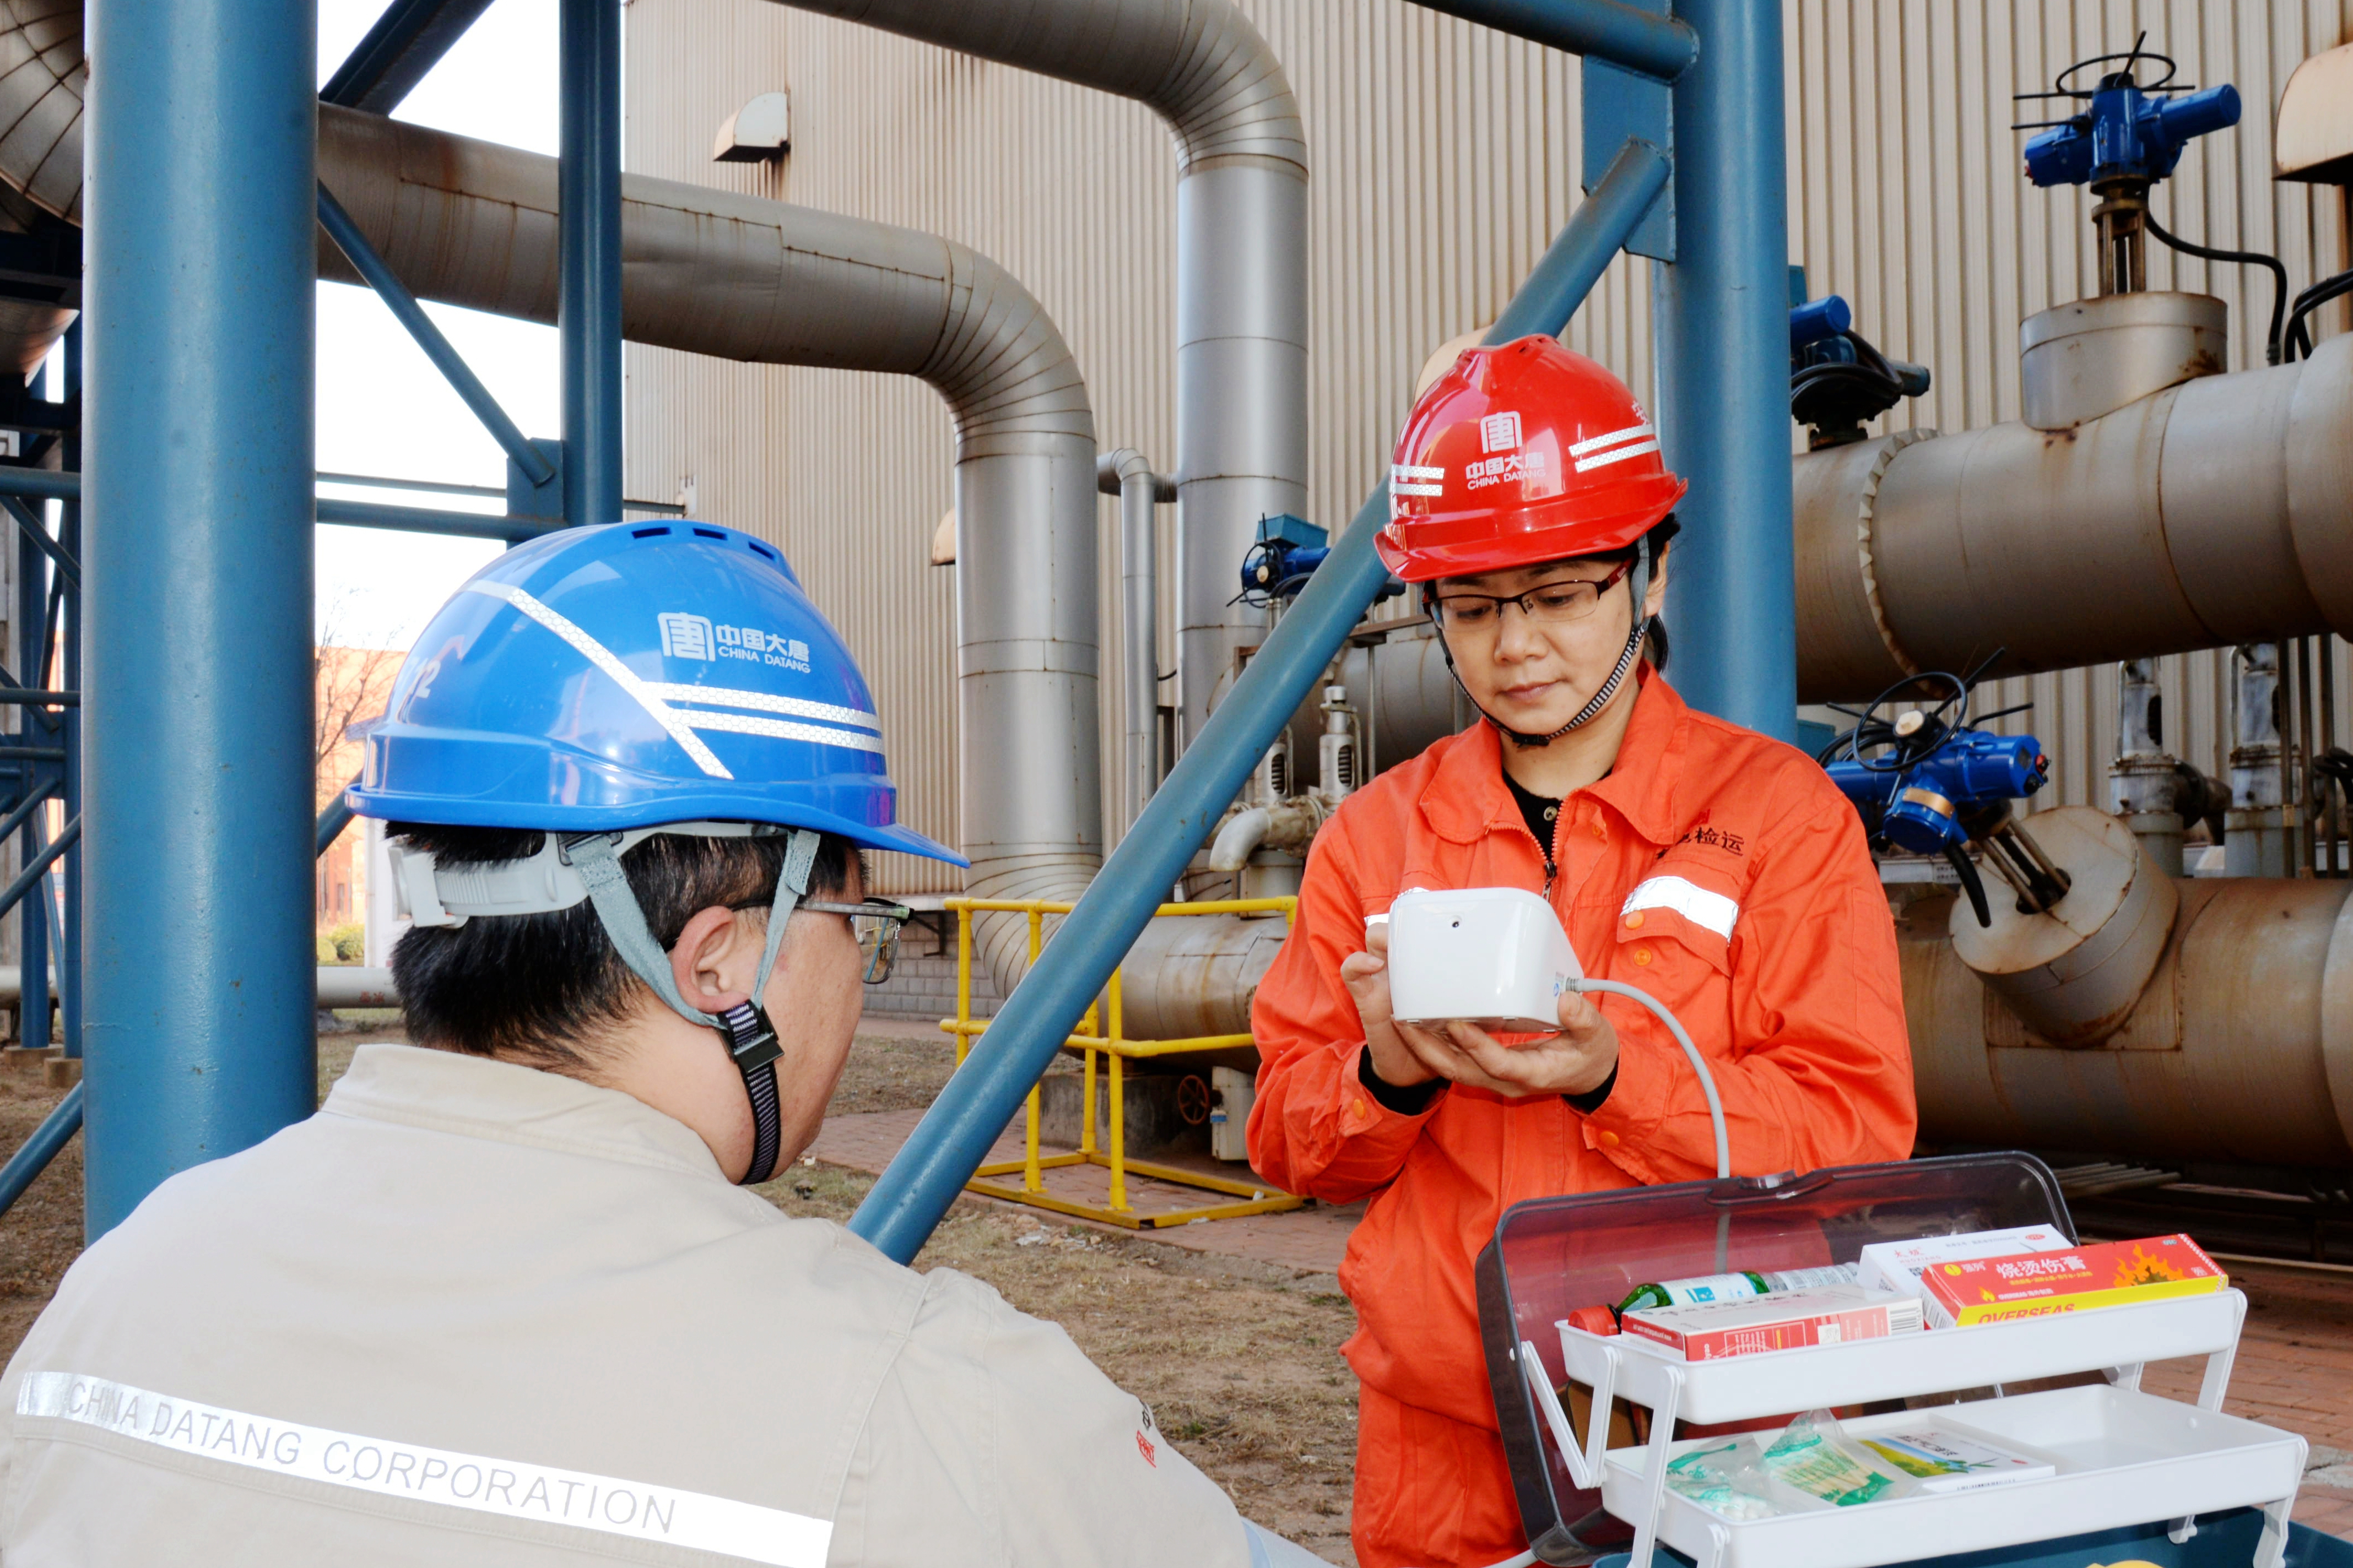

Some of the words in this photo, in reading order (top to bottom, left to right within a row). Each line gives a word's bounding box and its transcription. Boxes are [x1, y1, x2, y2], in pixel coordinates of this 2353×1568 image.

[1465, 452, 1544, 480] 中国大唐
[1467, 475, 1500, 490] CHINA
[1503, 469, 1546, 482] DATANG
[716, 625, 810, 662] 中国大唐
[717, 646, 760, 662] CHINA
[765, 653, 811, 674] DATANG
[1996, 1256, 2086, 1279] 烧烫伤膏
[1978, 1304, 2075, 1324] OVERSEAS
[67, 1382, 139, 1429] CHINA
[149, 1402, 302, 1465] DATANG
[323, 1440, 676, 1534] CORPORATION
